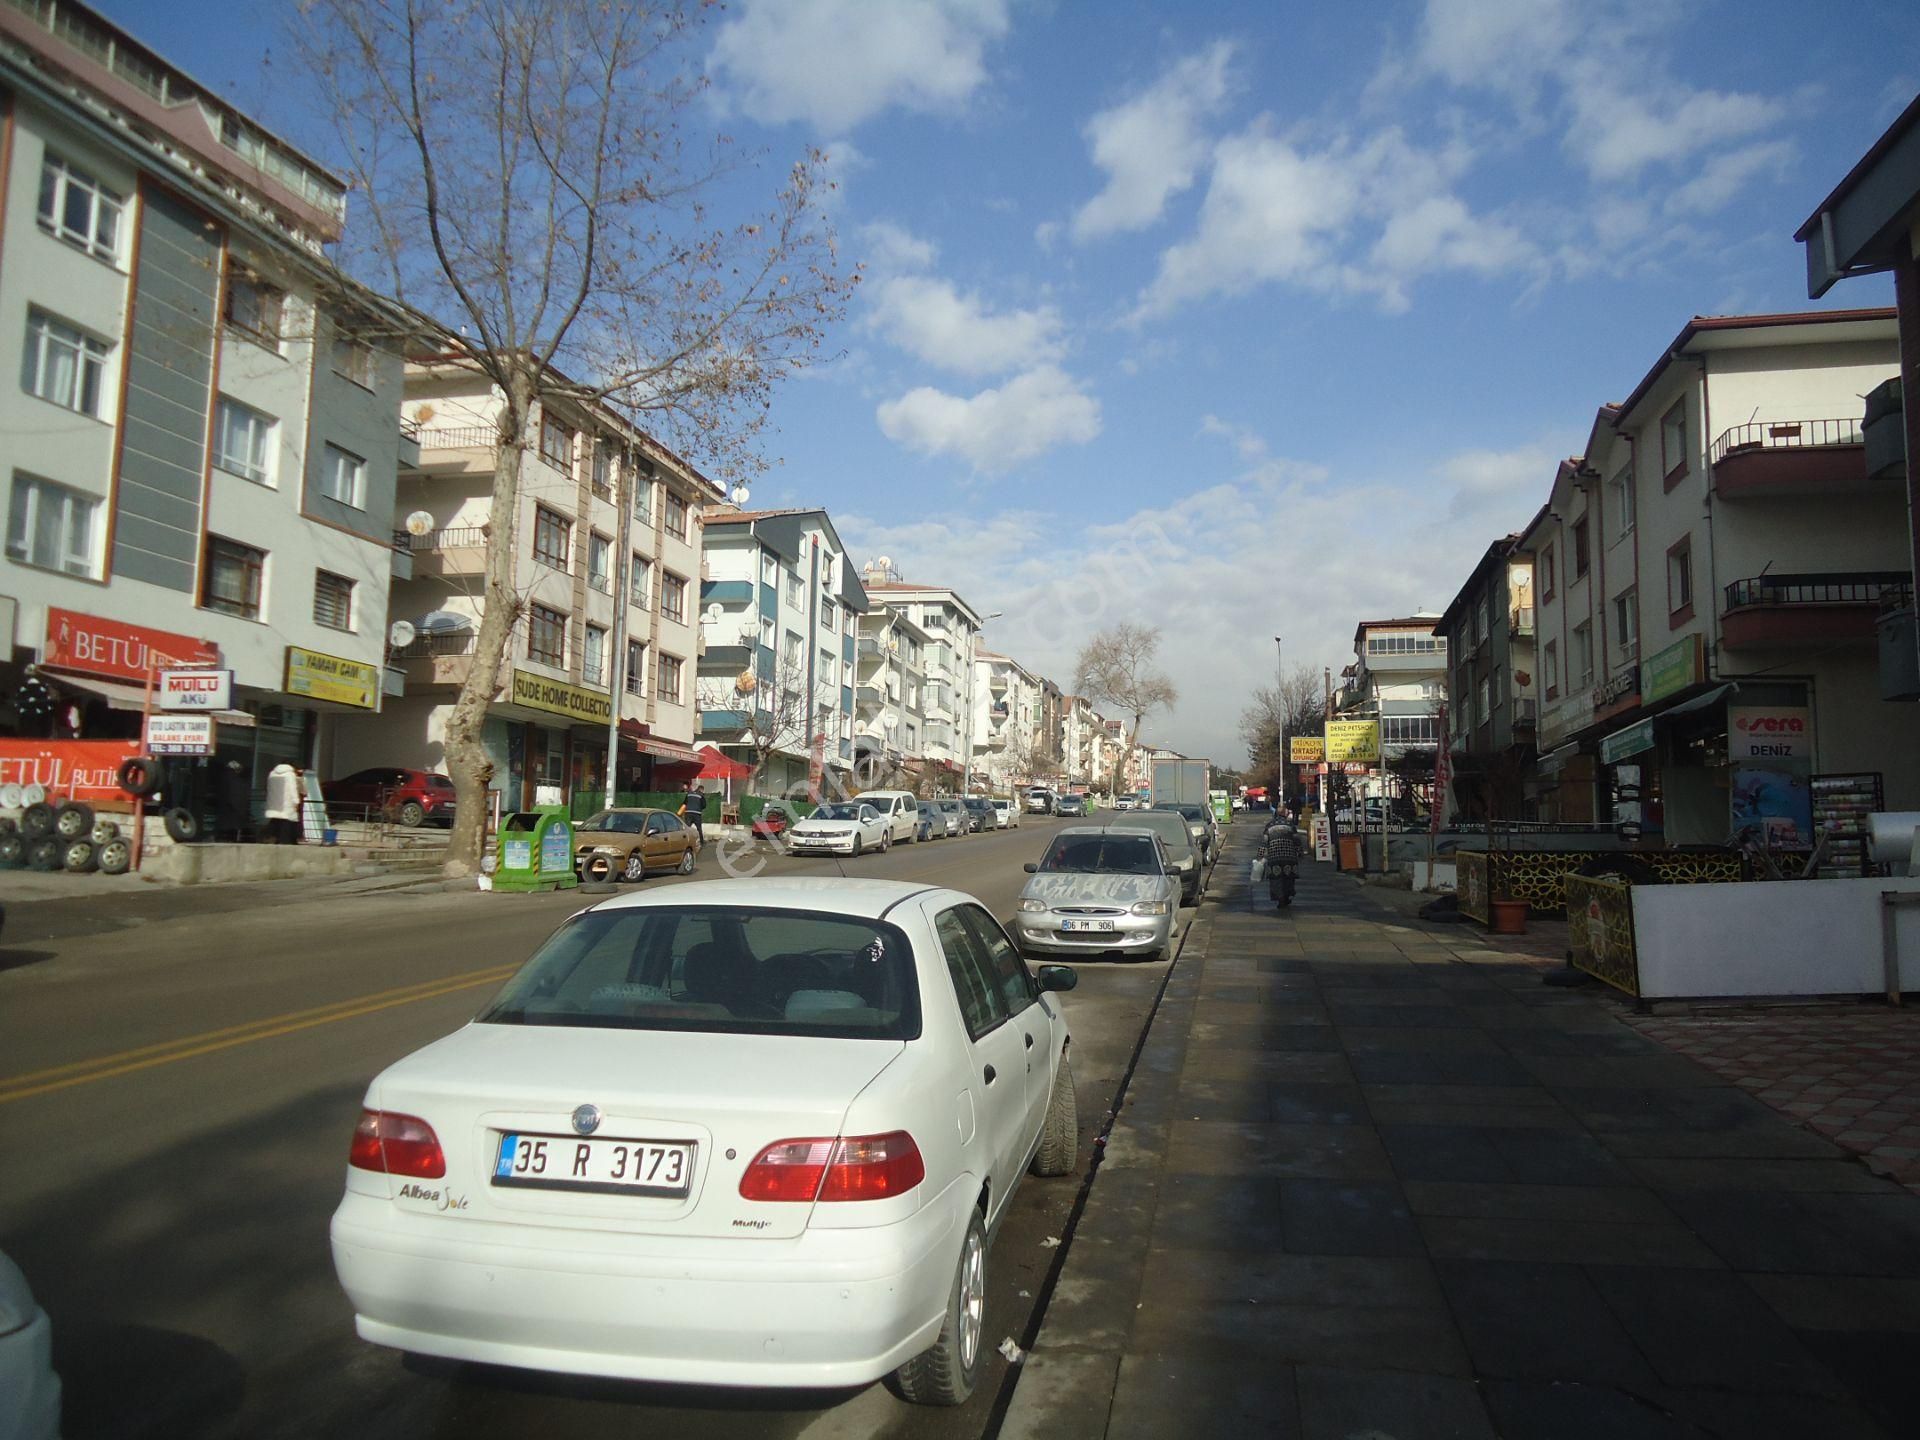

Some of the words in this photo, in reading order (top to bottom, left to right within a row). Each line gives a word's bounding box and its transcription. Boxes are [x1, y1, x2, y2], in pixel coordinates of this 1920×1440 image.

[75, 630, 151, 671] BETÜL
[168, 676, 218, 692] MUTLU
[515, 678, 540, 700] SUDE
[542, 685, 568, 708] HOME
[570, 693, 611, 718] COLLECTIO
[1750, 743, 1793, 757] DENİZ
[0, 752, 69, 788] ETÜL
[1358, 824, 1375, 833] EKEK
[1376, 822, 1401, 833] KUFÖRÜ
[1067, 921, 1076, 930] 06
[1081, 921, 1090, 930] PM
[515, 1140, 548, 1174] 35
[572, 1143, 591, 1177] R
[610, 1146, 684, 1183] 3173
[399, 1184, 440, 1202] Albea
